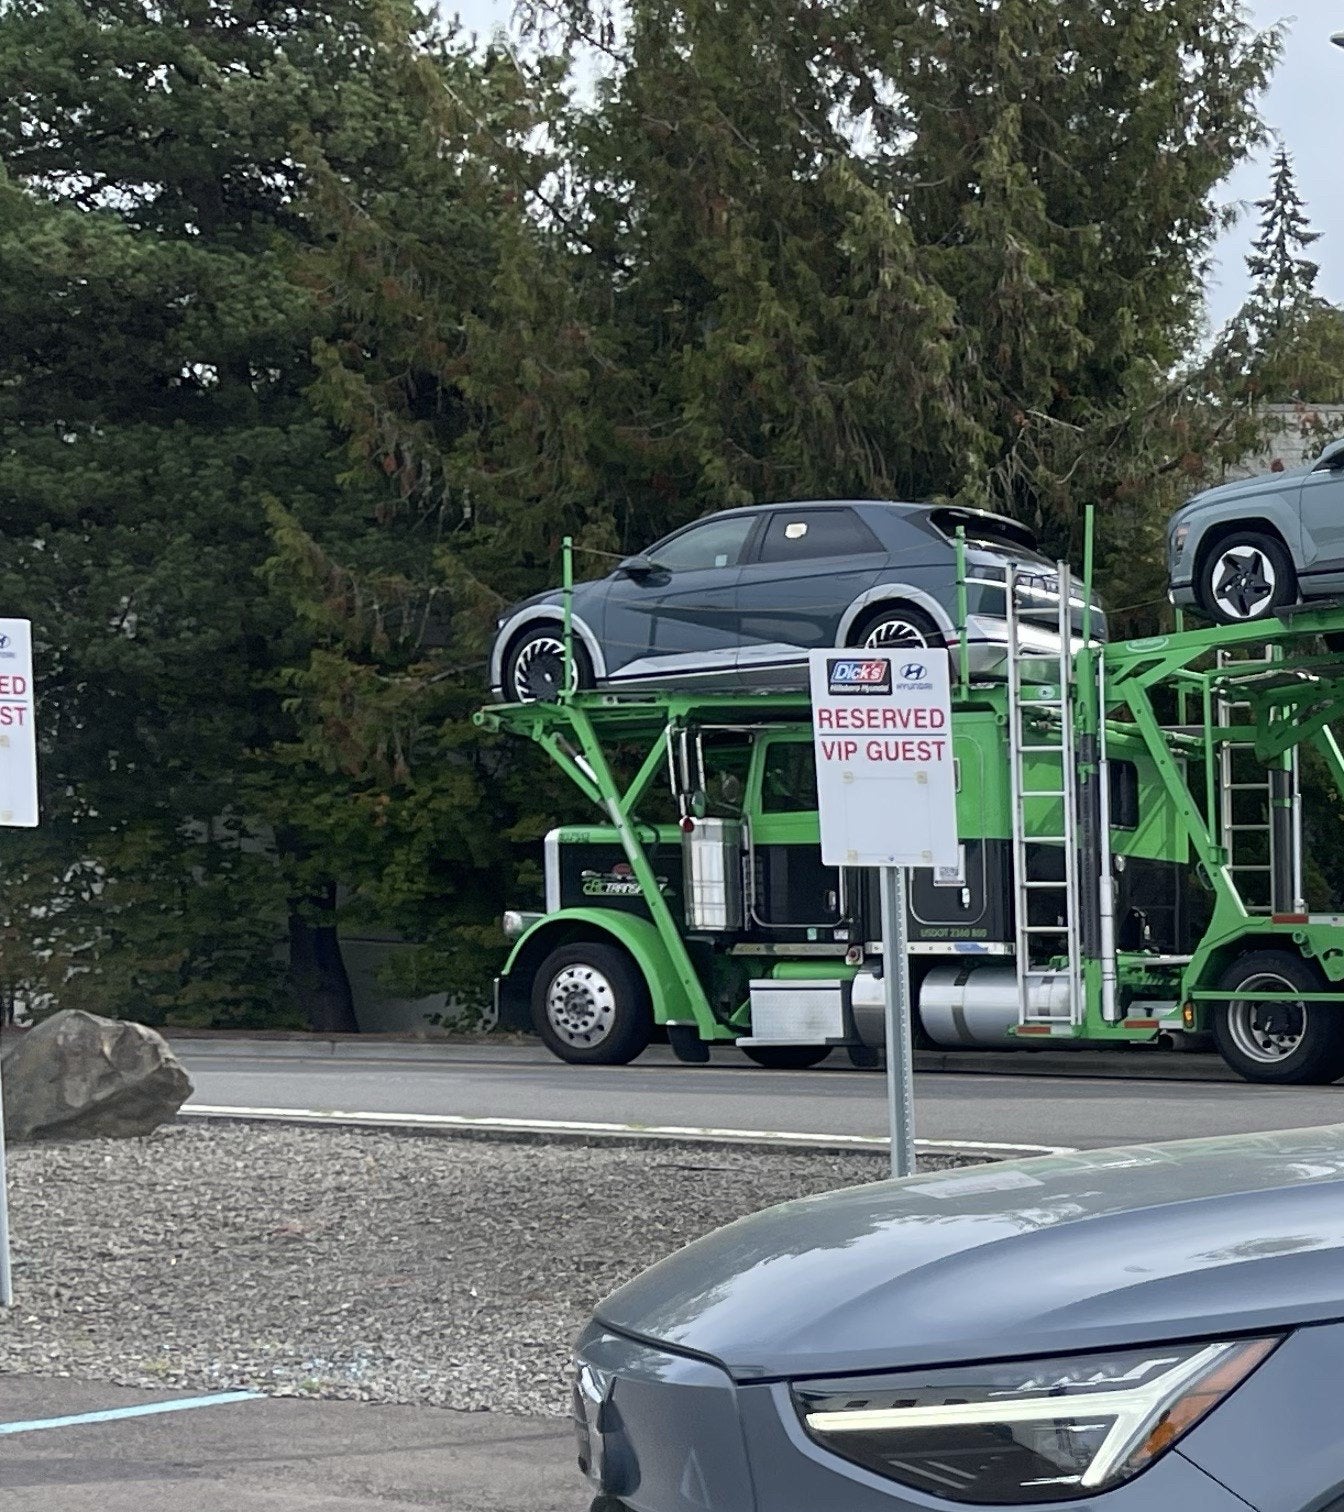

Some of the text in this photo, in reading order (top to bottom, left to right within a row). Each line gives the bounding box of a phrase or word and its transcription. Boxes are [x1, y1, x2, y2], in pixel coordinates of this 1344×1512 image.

[818, 708, 945, 729] RESERVED
[821, 740, 945, 761] VIP GUEST
